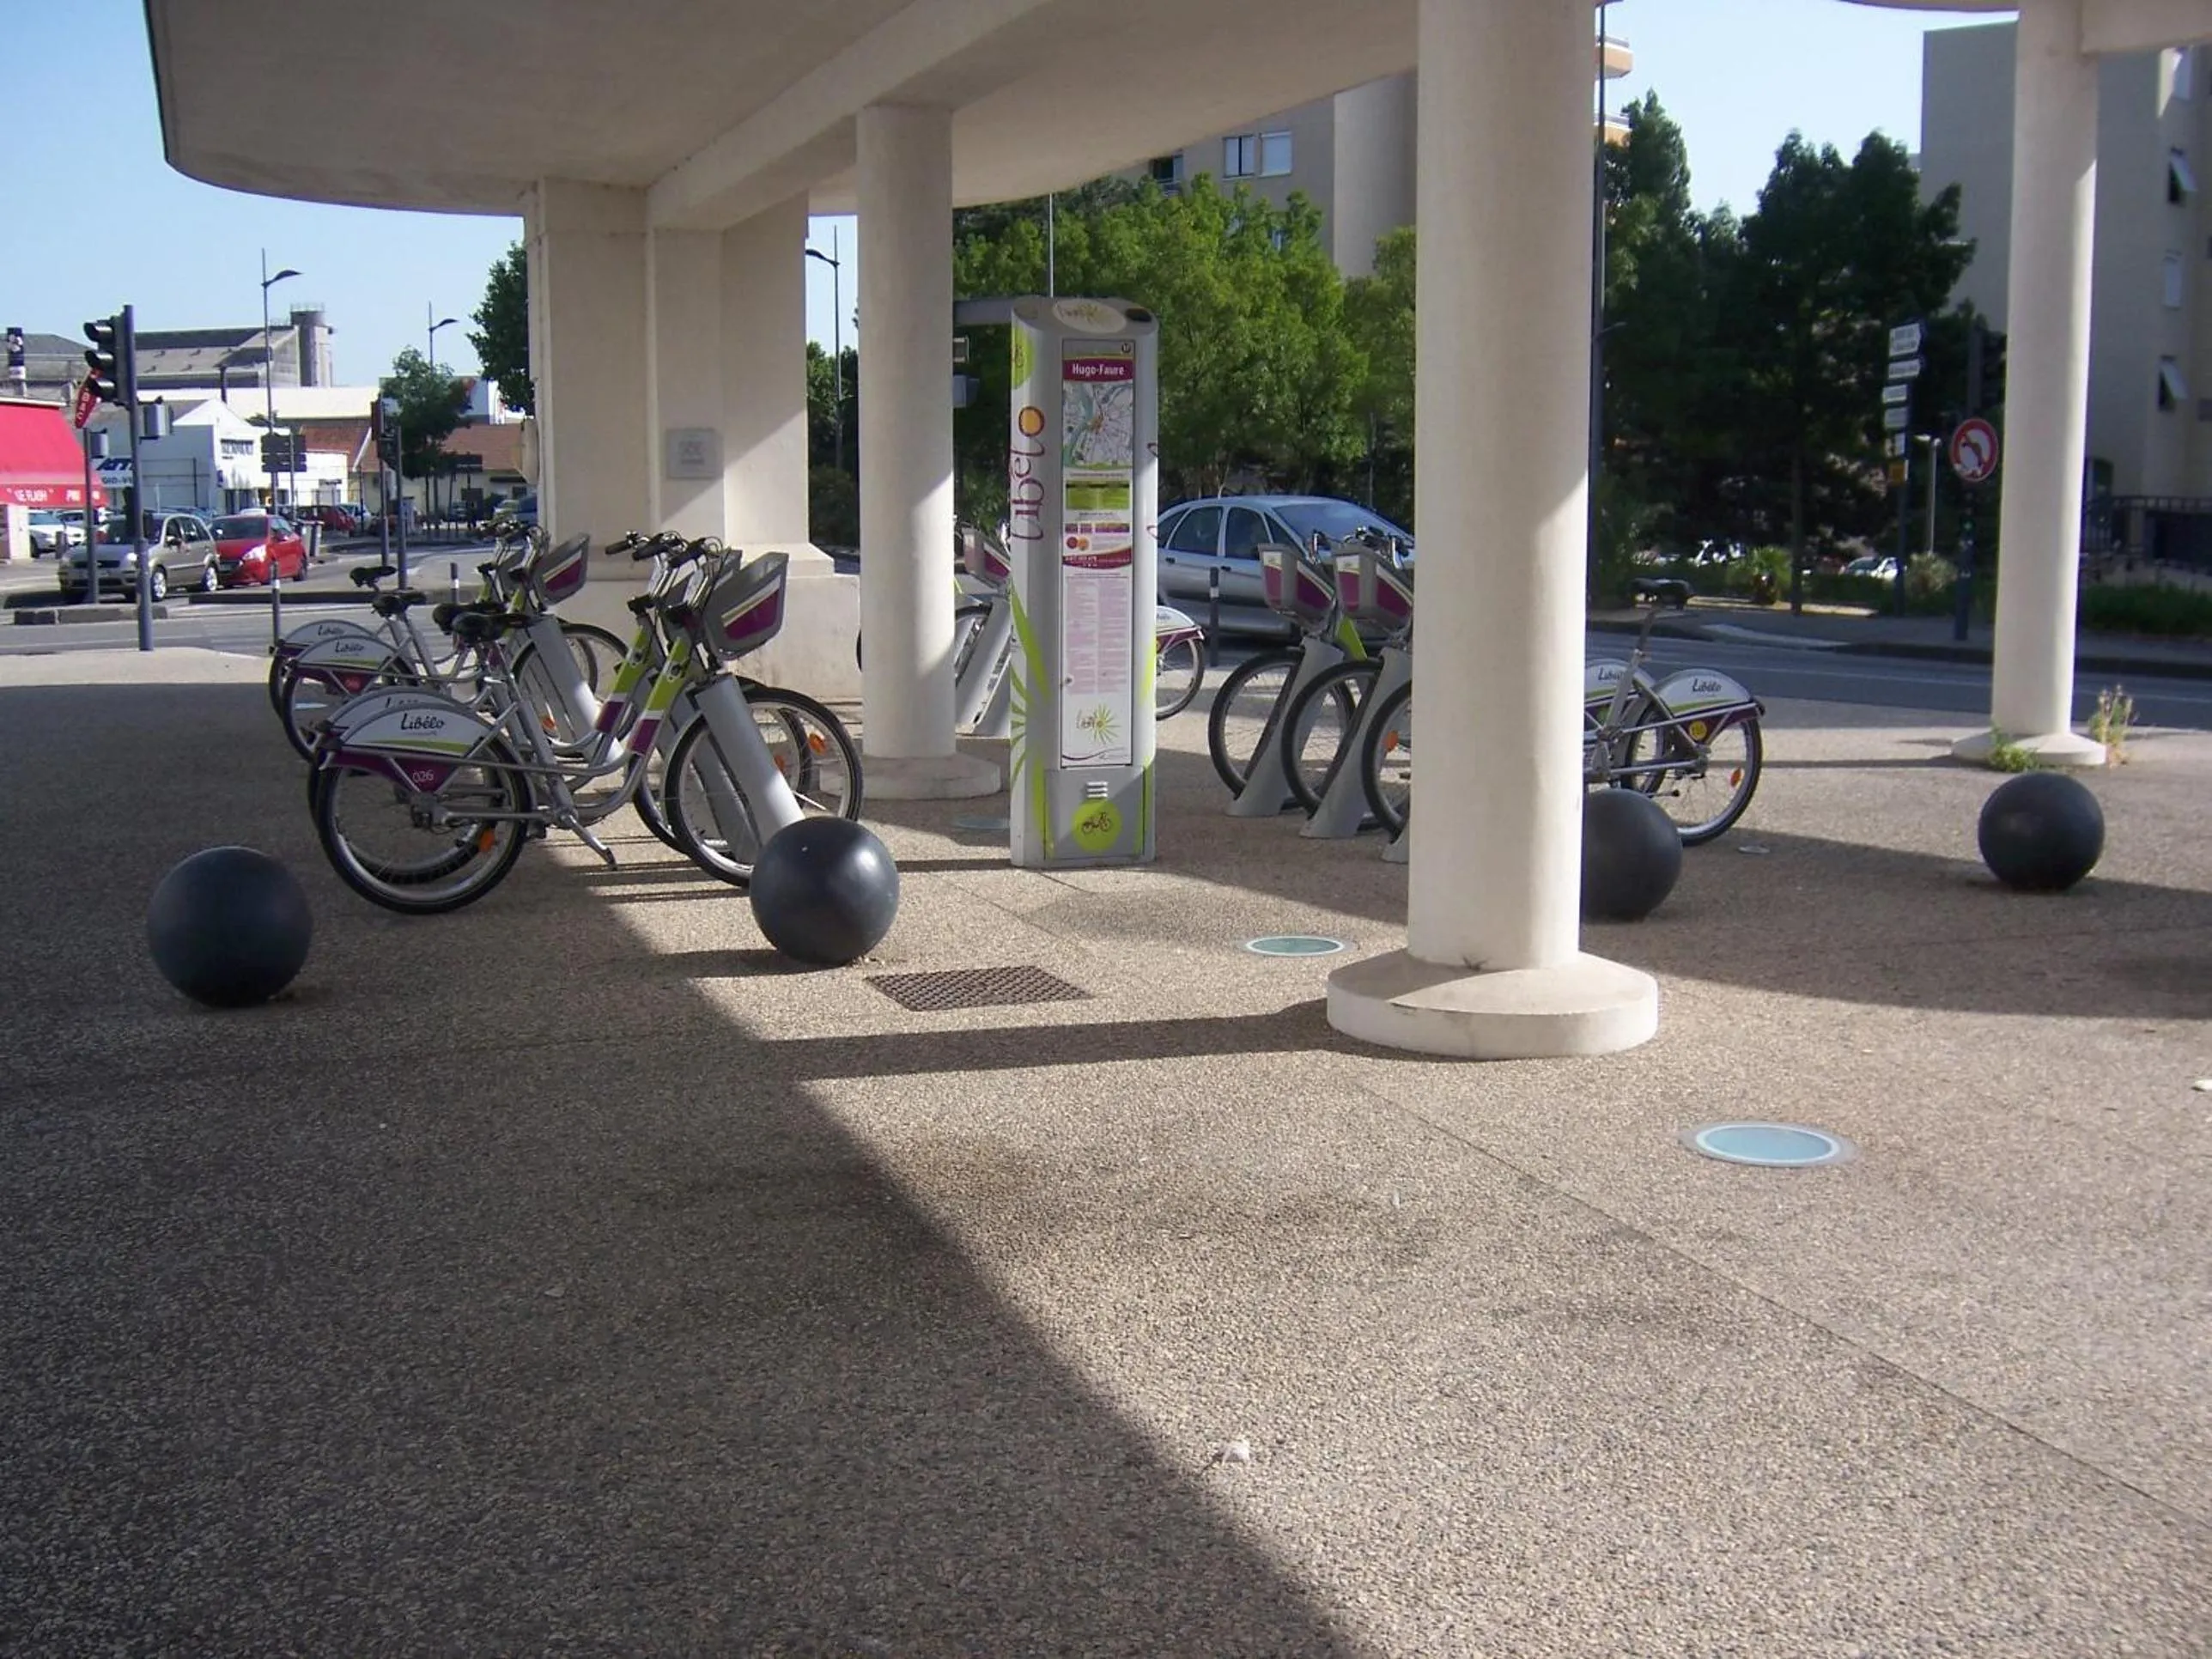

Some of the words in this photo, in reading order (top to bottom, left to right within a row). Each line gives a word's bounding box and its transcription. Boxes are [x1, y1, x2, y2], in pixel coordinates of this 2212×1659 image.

[1072, 363, 1125, 377] Hugo-Faure
[1692, 678, 1723, 693] Libélo
[401, 713, 445, 730] Libélo
